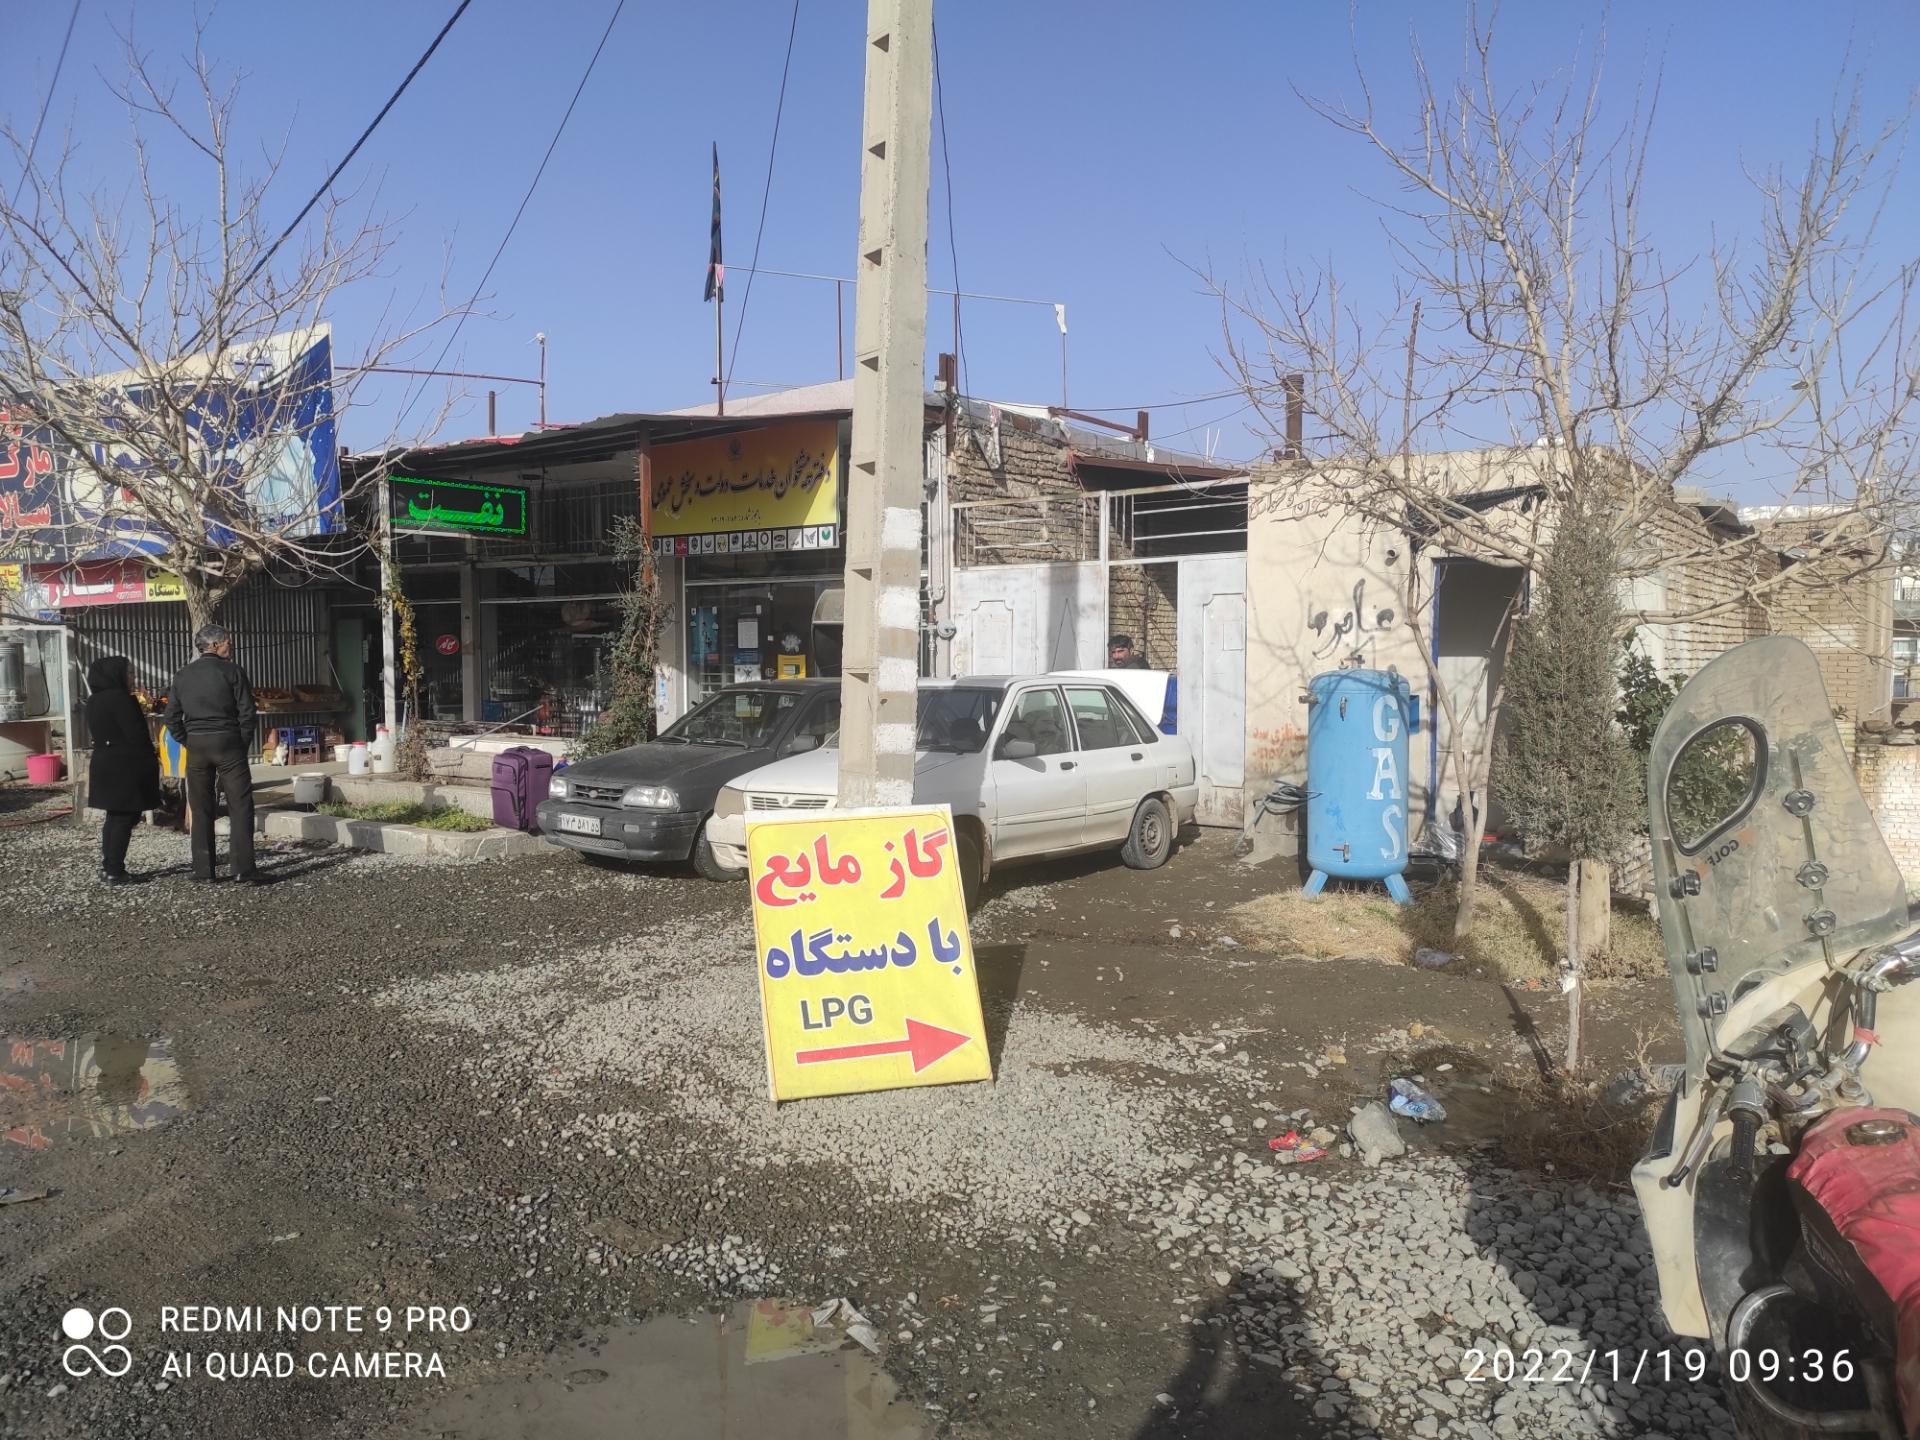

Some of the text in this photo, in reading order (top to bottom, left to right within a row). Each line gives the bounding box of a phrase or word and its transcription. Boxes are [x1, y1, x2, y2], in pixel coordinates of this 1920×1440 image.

[0, 436, 52, 488] مارک
[48, 568, 115, 607] سالار
[1366, 694, 1403, 861] GAS
[757, 828, 949, 907] گاز مایع
[766, 917, 962, 979] با دستگاه
[801, 994, 874, 1030] LPG
